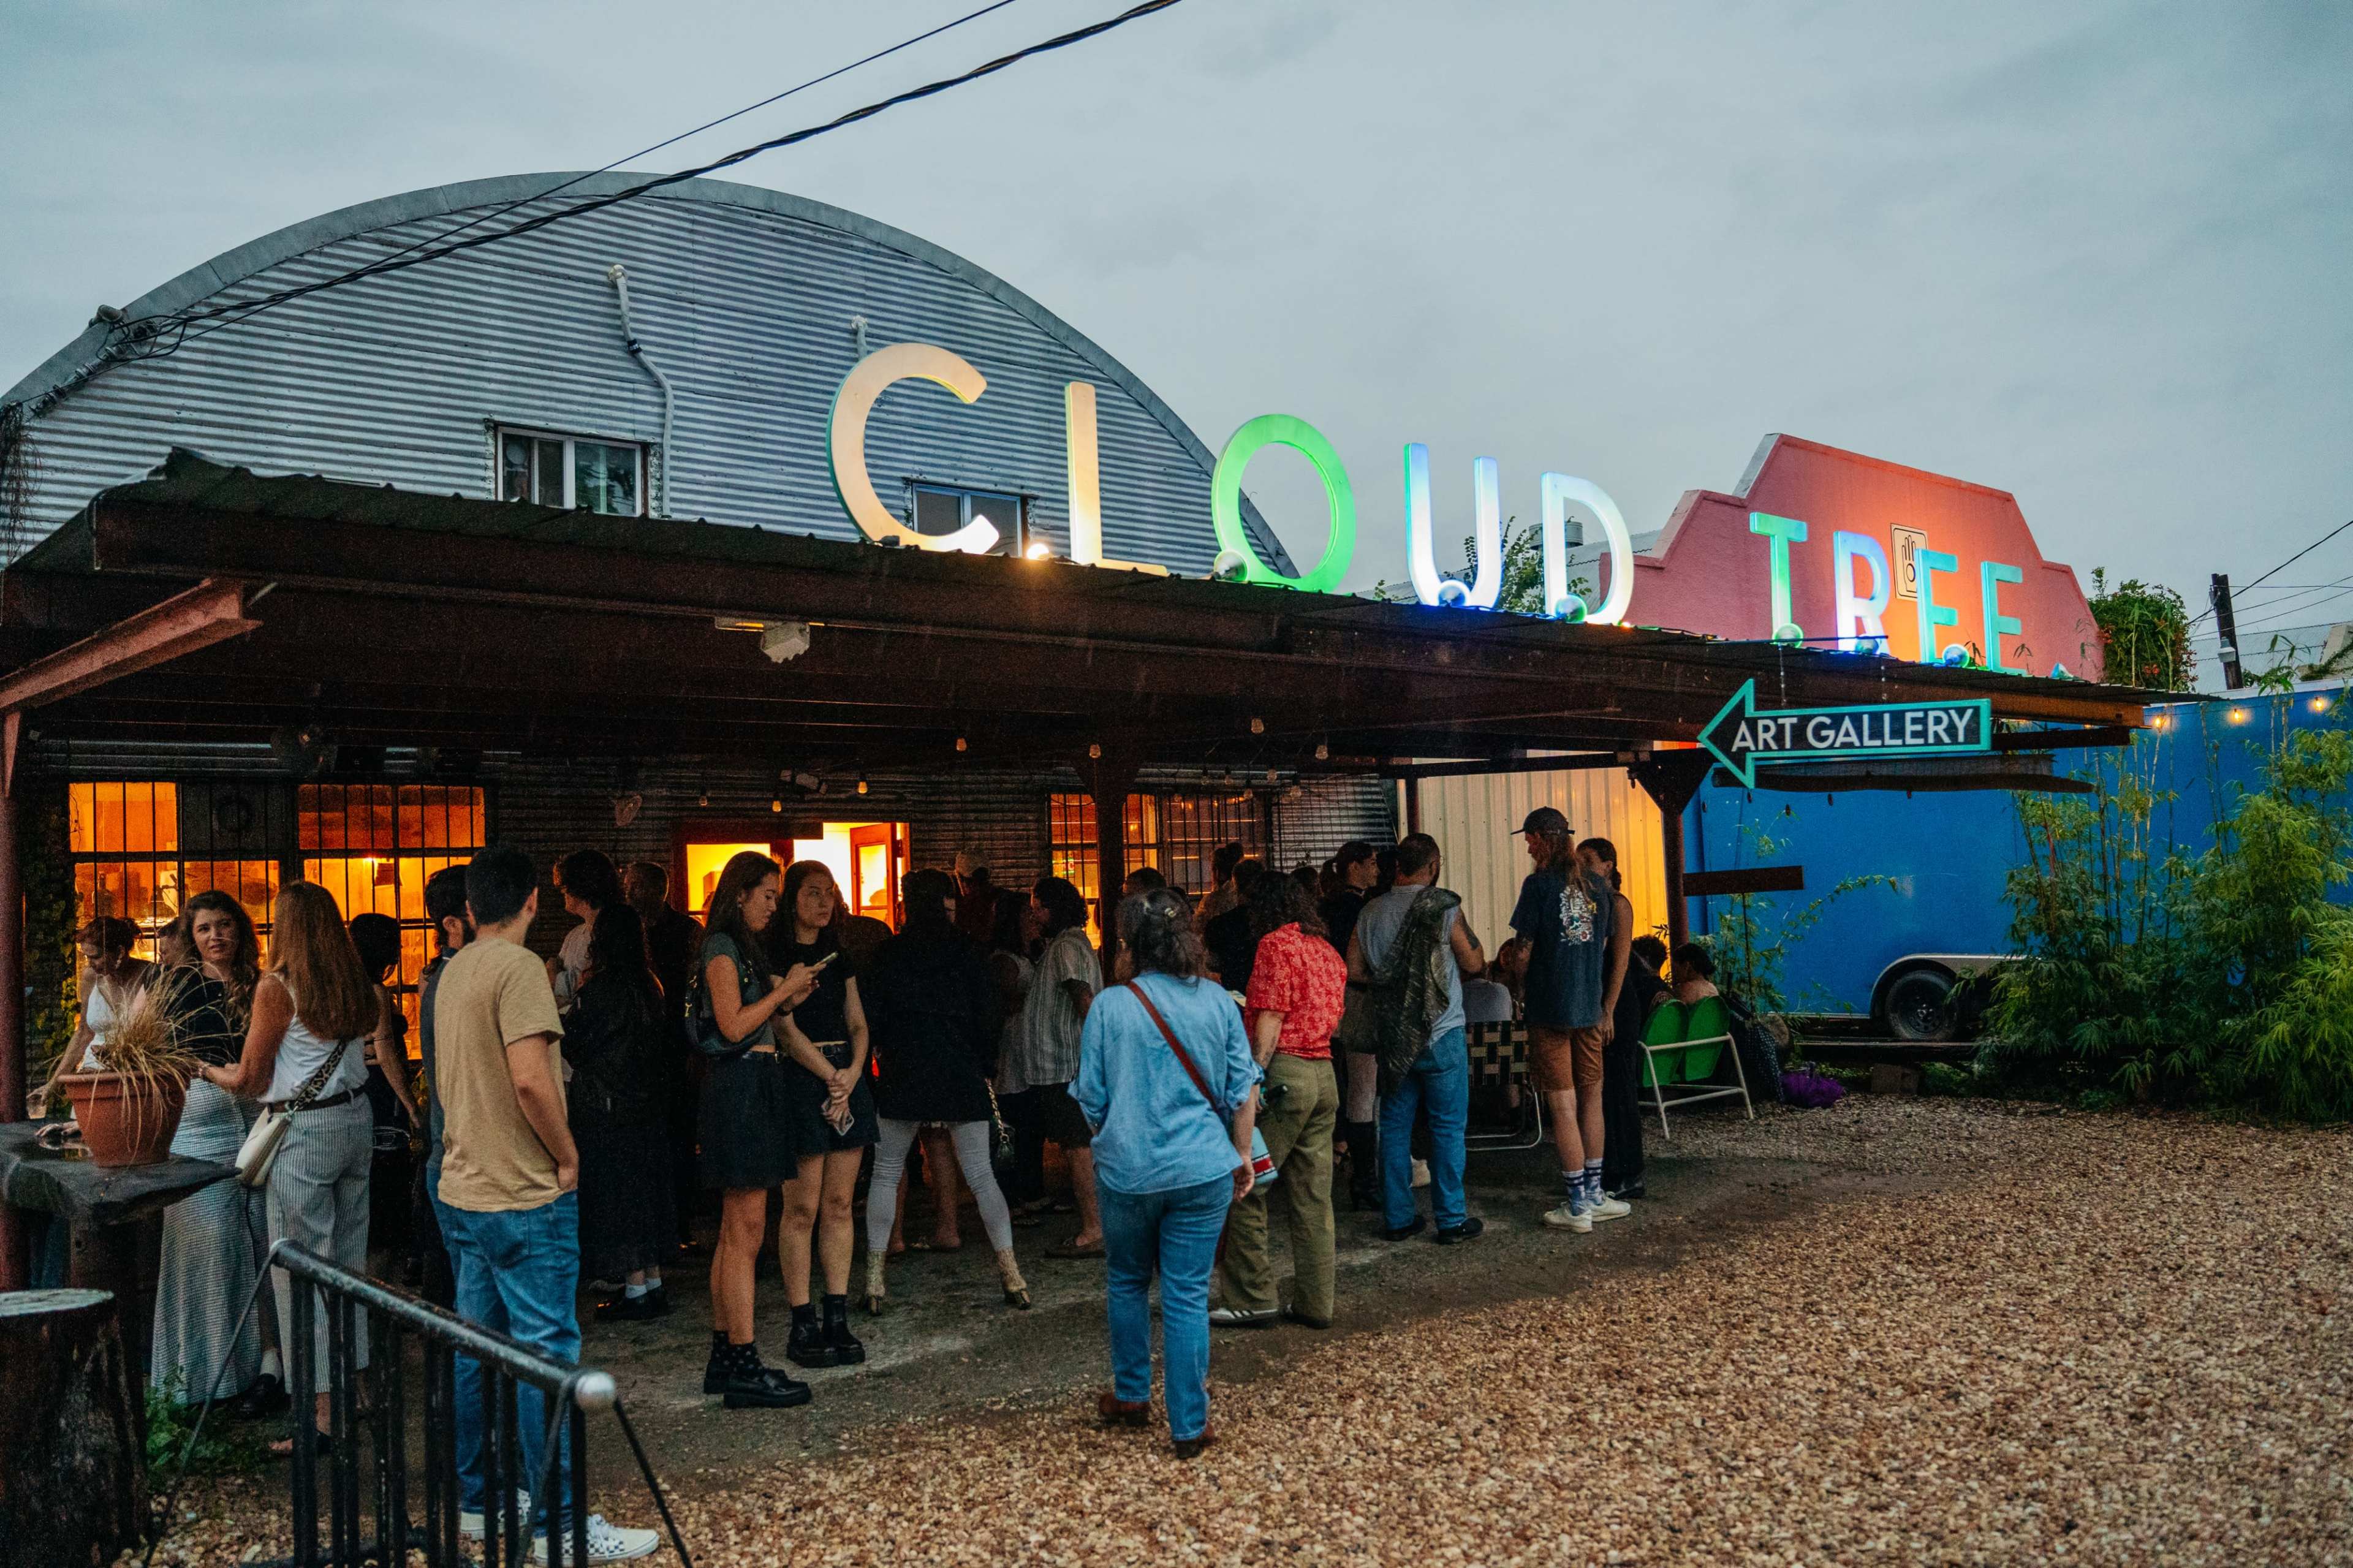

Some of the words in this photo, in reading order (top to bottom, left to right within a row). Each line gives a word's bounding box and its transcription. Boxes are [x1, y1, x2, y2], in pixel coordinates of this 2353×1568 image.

[827, 343, 1634, 625] CLOUD
[1749, 512, 2028, 675] TREE
[1731, 717, 1797, 752] ART
[1806, 709, 1974, 749] GALLERY
